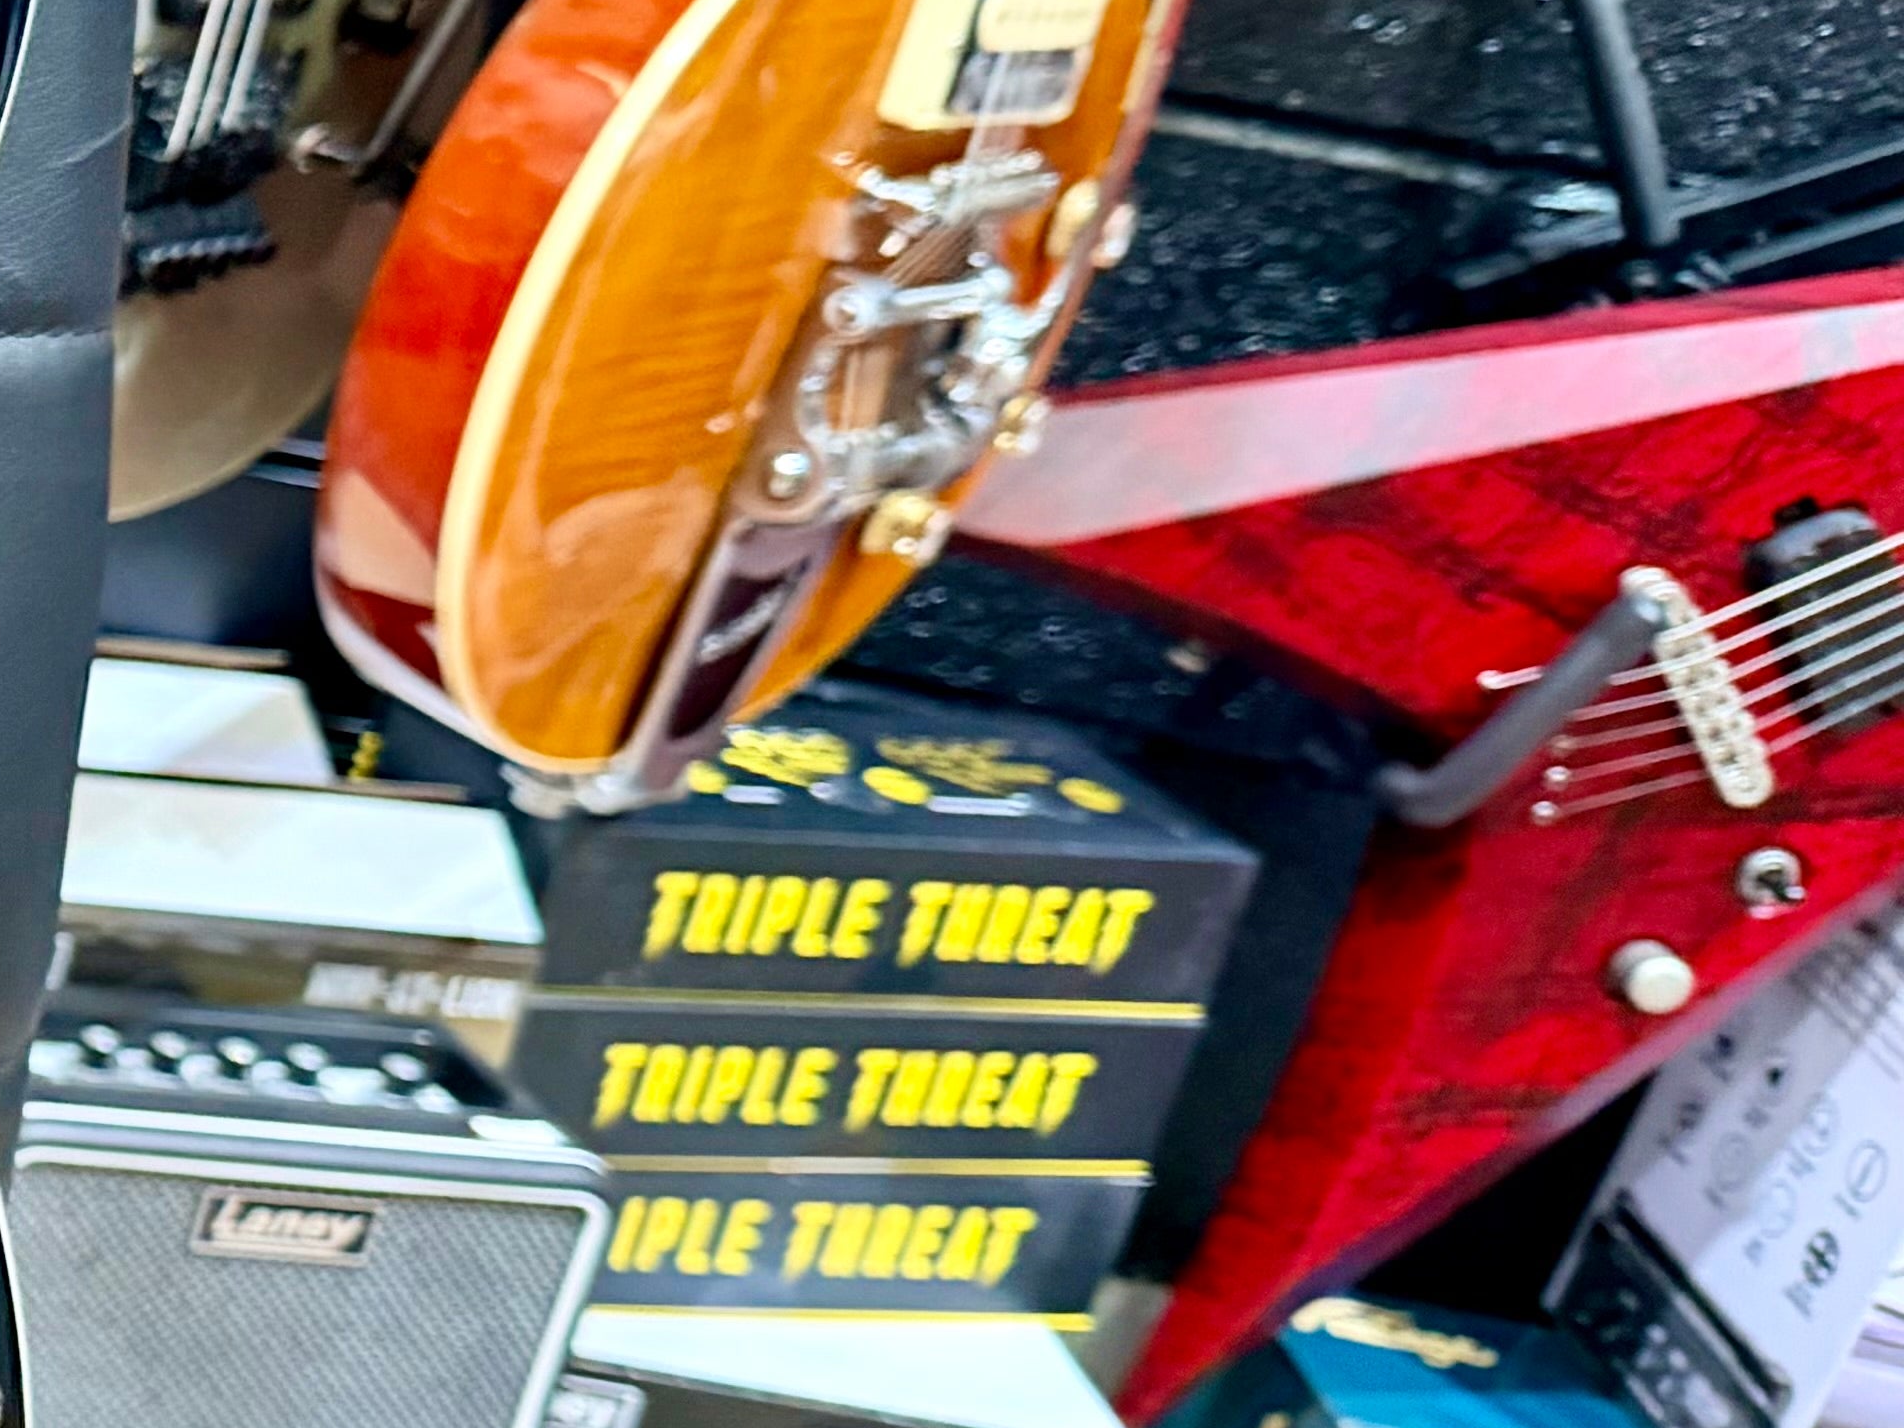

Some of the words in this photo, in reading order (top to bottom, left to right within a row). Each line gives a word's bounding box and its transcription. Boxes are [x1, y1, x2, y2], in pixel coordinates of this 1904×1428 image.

[643, 872, 890, 960] TRIPLE
[898, 881, 1154, 976] THREAT
[595, 1042, 838, 1129] TRIPLE
[845, 1048, 1098, 1136] THREAT
[782, 1201, 1038, 1287] THREAT
